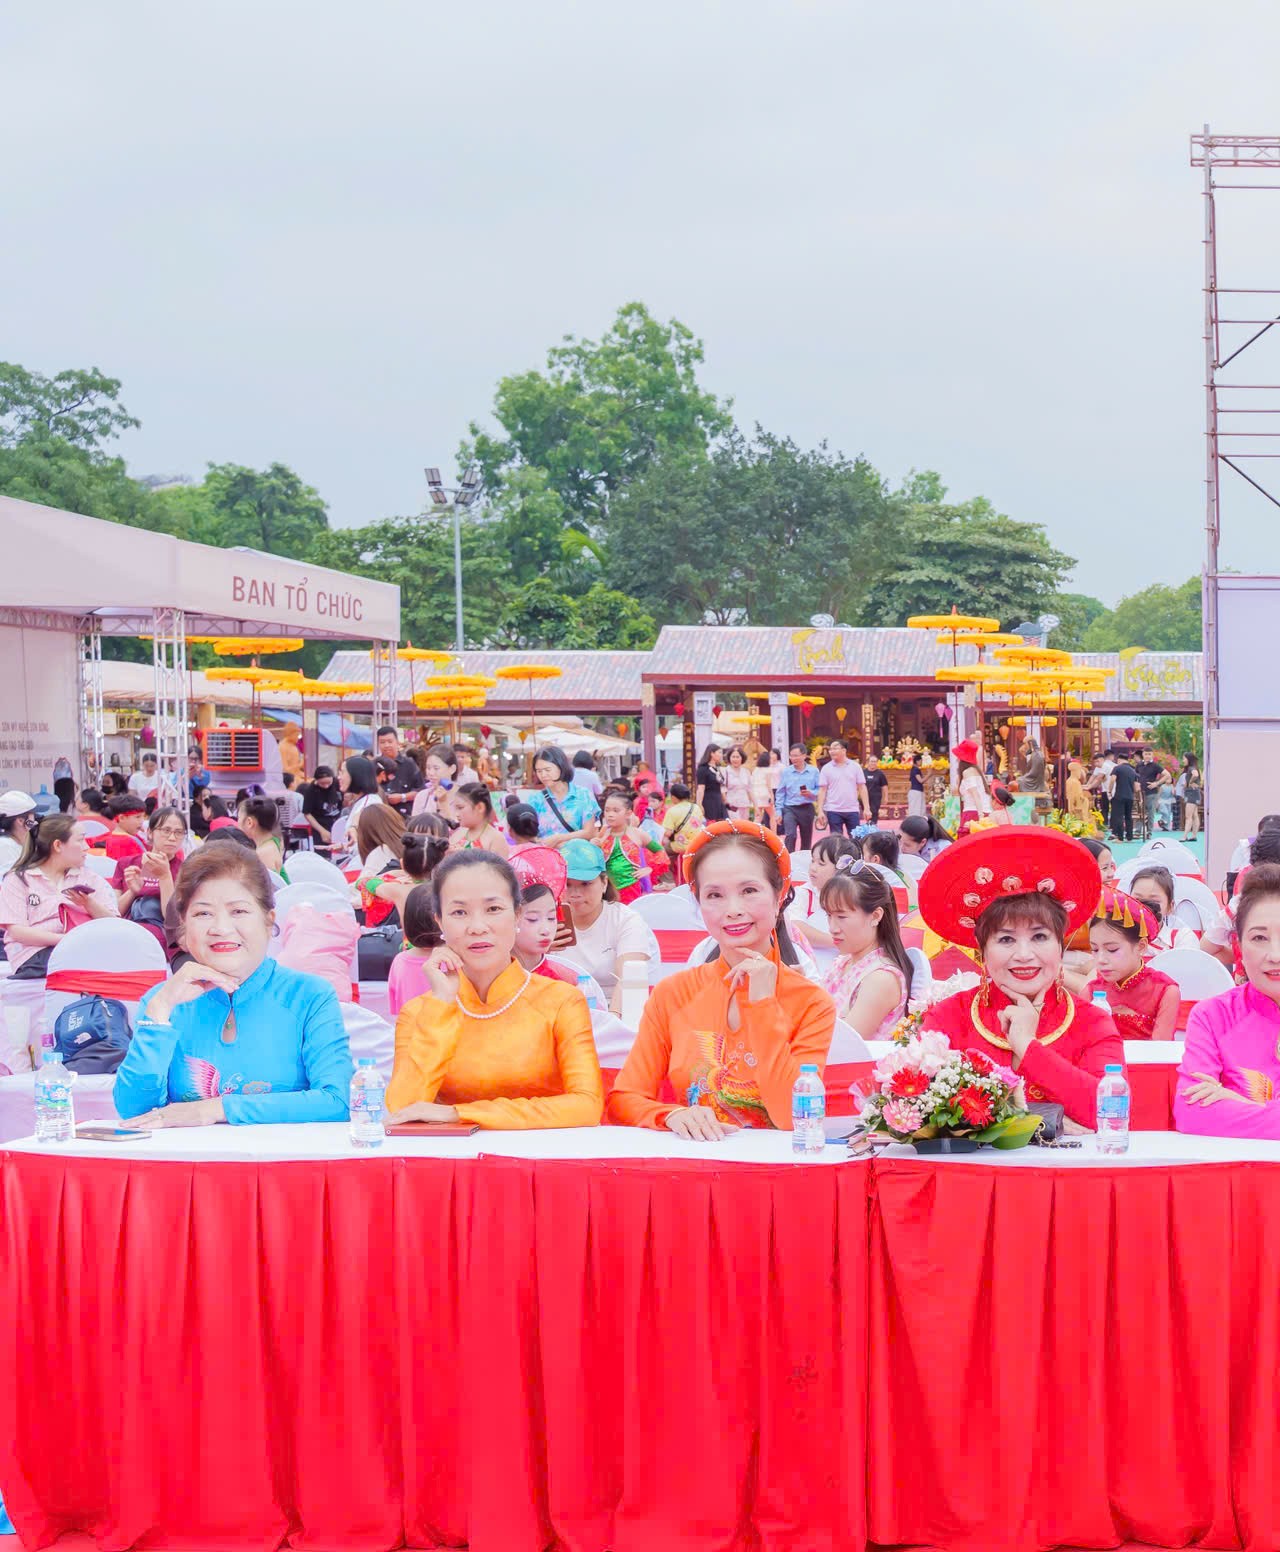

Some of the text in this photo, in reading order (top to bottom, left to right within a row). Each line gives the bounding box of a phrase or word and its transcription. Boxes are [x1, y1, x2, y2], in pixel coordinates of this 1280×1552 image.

[232, 575, 363, 621] BAN TỔ CHỨC
